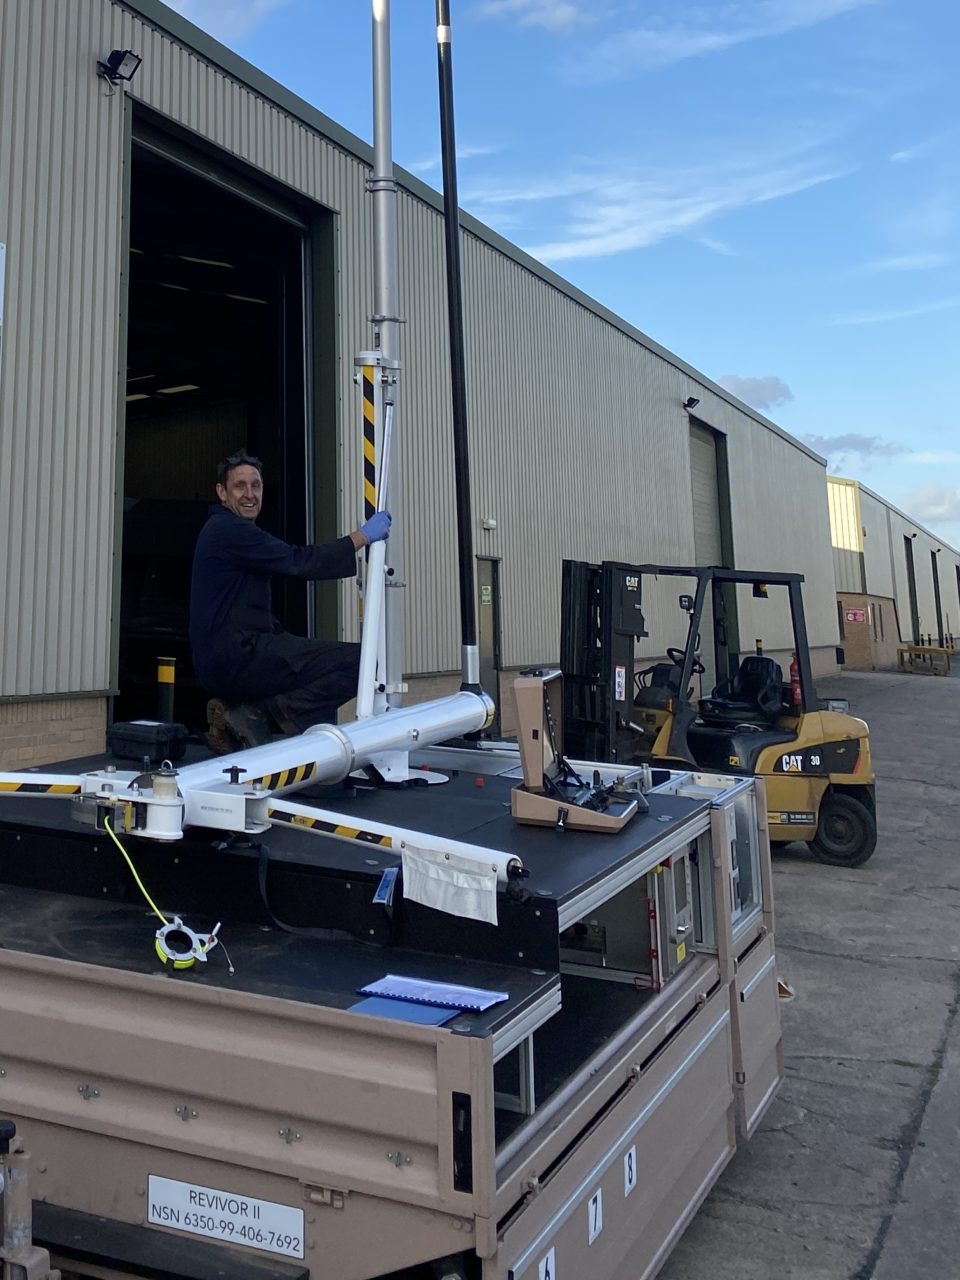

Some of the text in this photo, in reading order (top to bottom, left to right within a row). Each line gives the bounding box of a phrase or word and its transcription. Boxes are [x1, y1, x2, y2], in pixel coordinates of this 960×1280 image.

[625, 576, 639, 587] CAT
[782, 755, 802, 771] CAT
[810, 755, 820, 766] 30
[627, 1152, 633, 1185] 8
[189, 1190, 260, 1220] REVIVOR II
[592, 1195, 598, 1232] 7
[152, 1204, 300, 1252] NSN 6350-99-406-7692
